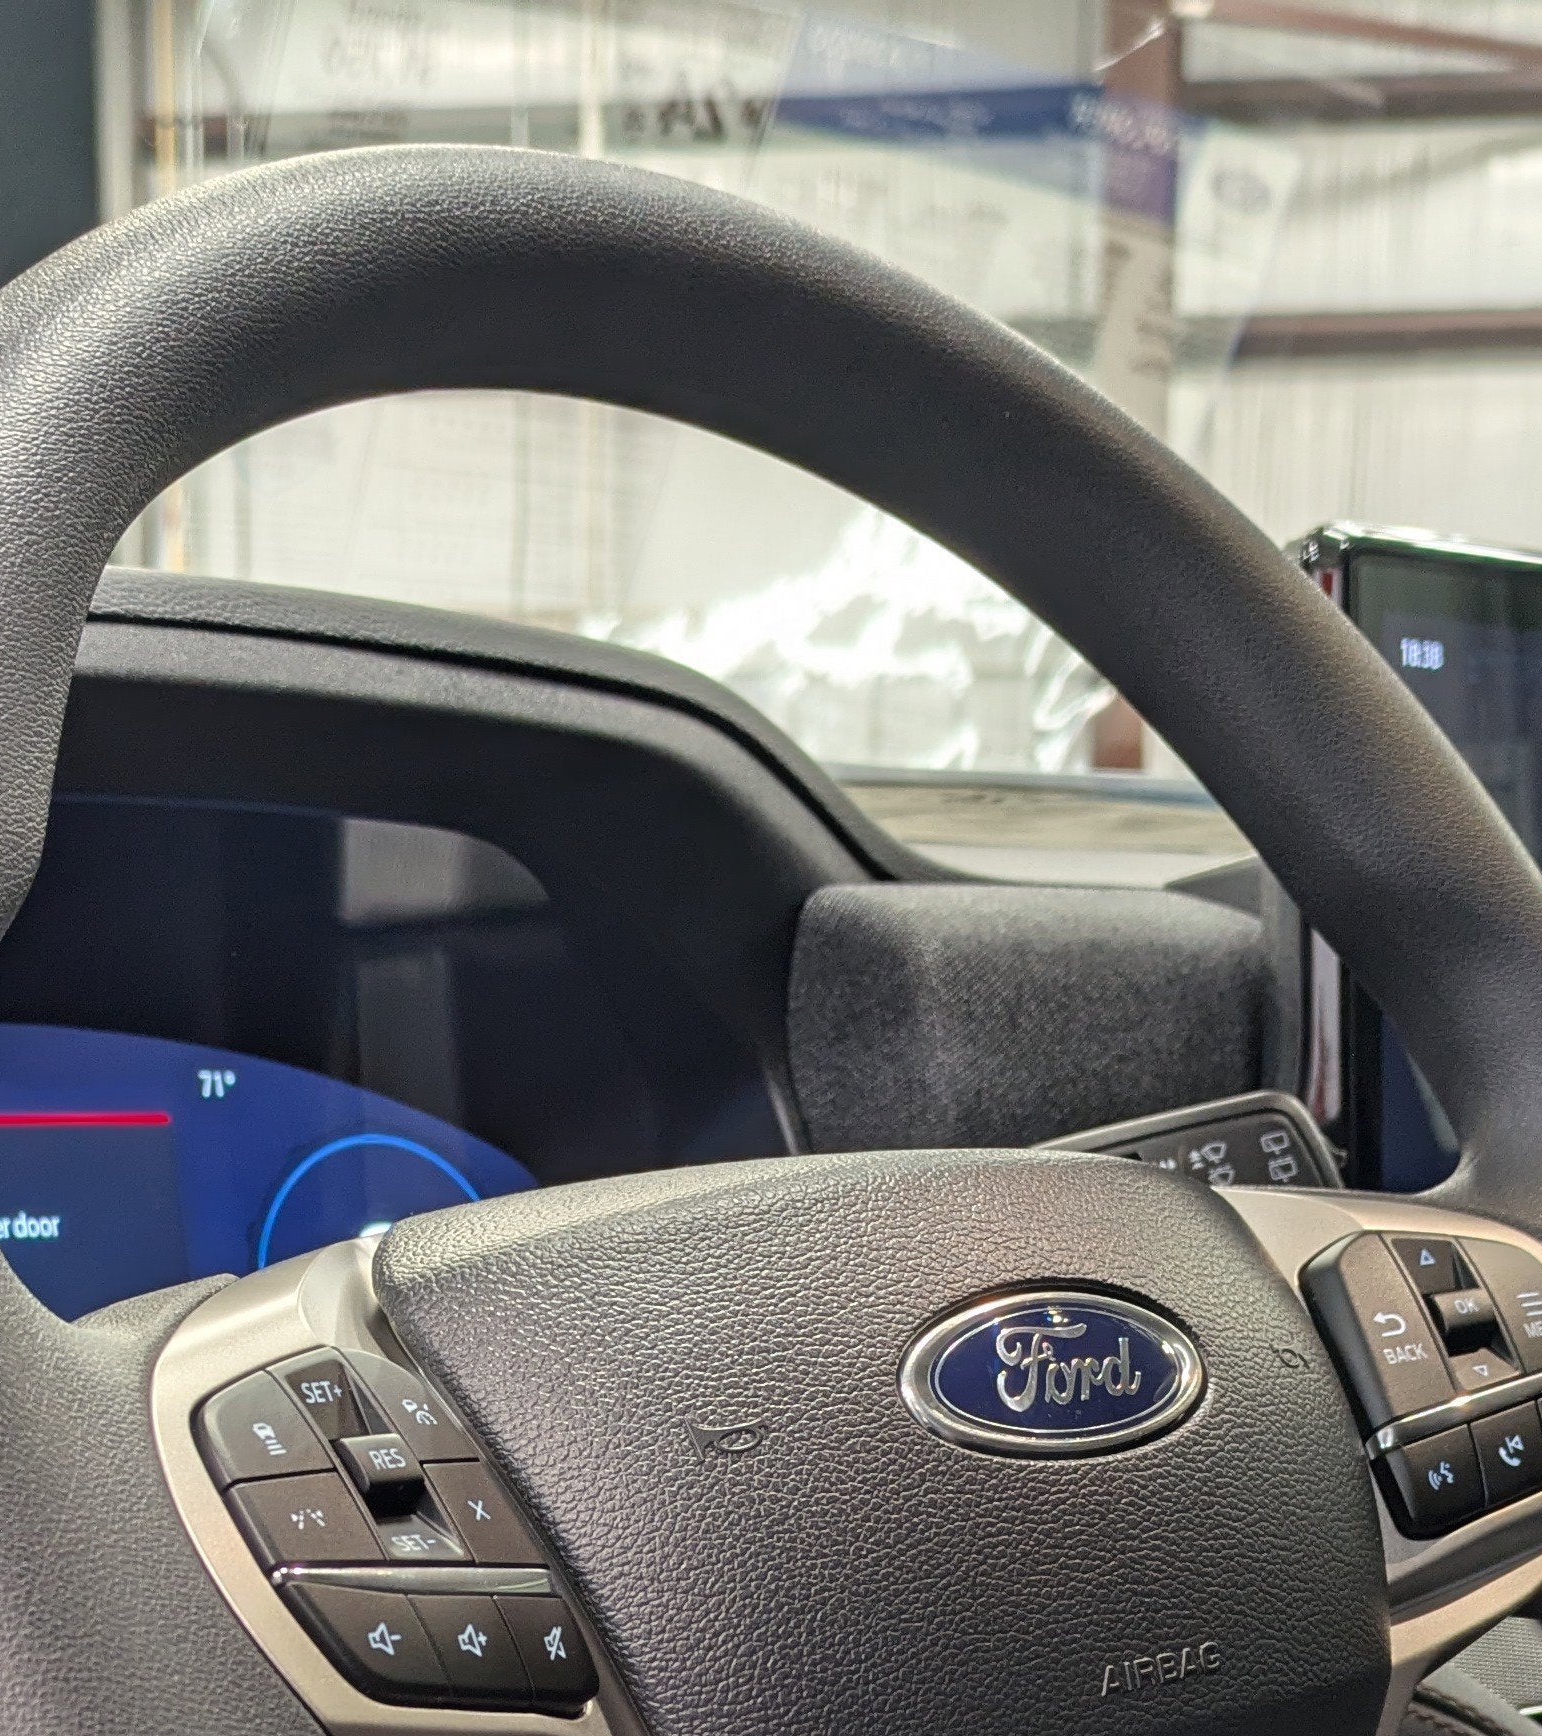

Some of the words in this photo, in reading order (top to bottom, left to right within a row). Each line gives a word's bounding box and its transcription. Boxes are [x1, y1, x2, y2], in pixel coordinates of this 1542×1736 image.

[12, 1210, 60, 1239] door
[1454, 1297, 1479, 1315] OK
[1382, 1342, 1428, 1365] BACK
[995, 1322, 1143, 1413] Ford
[368, 1447, 407, 1471] RES
[1100, 1641, 1221, 1697] AIRBAG
